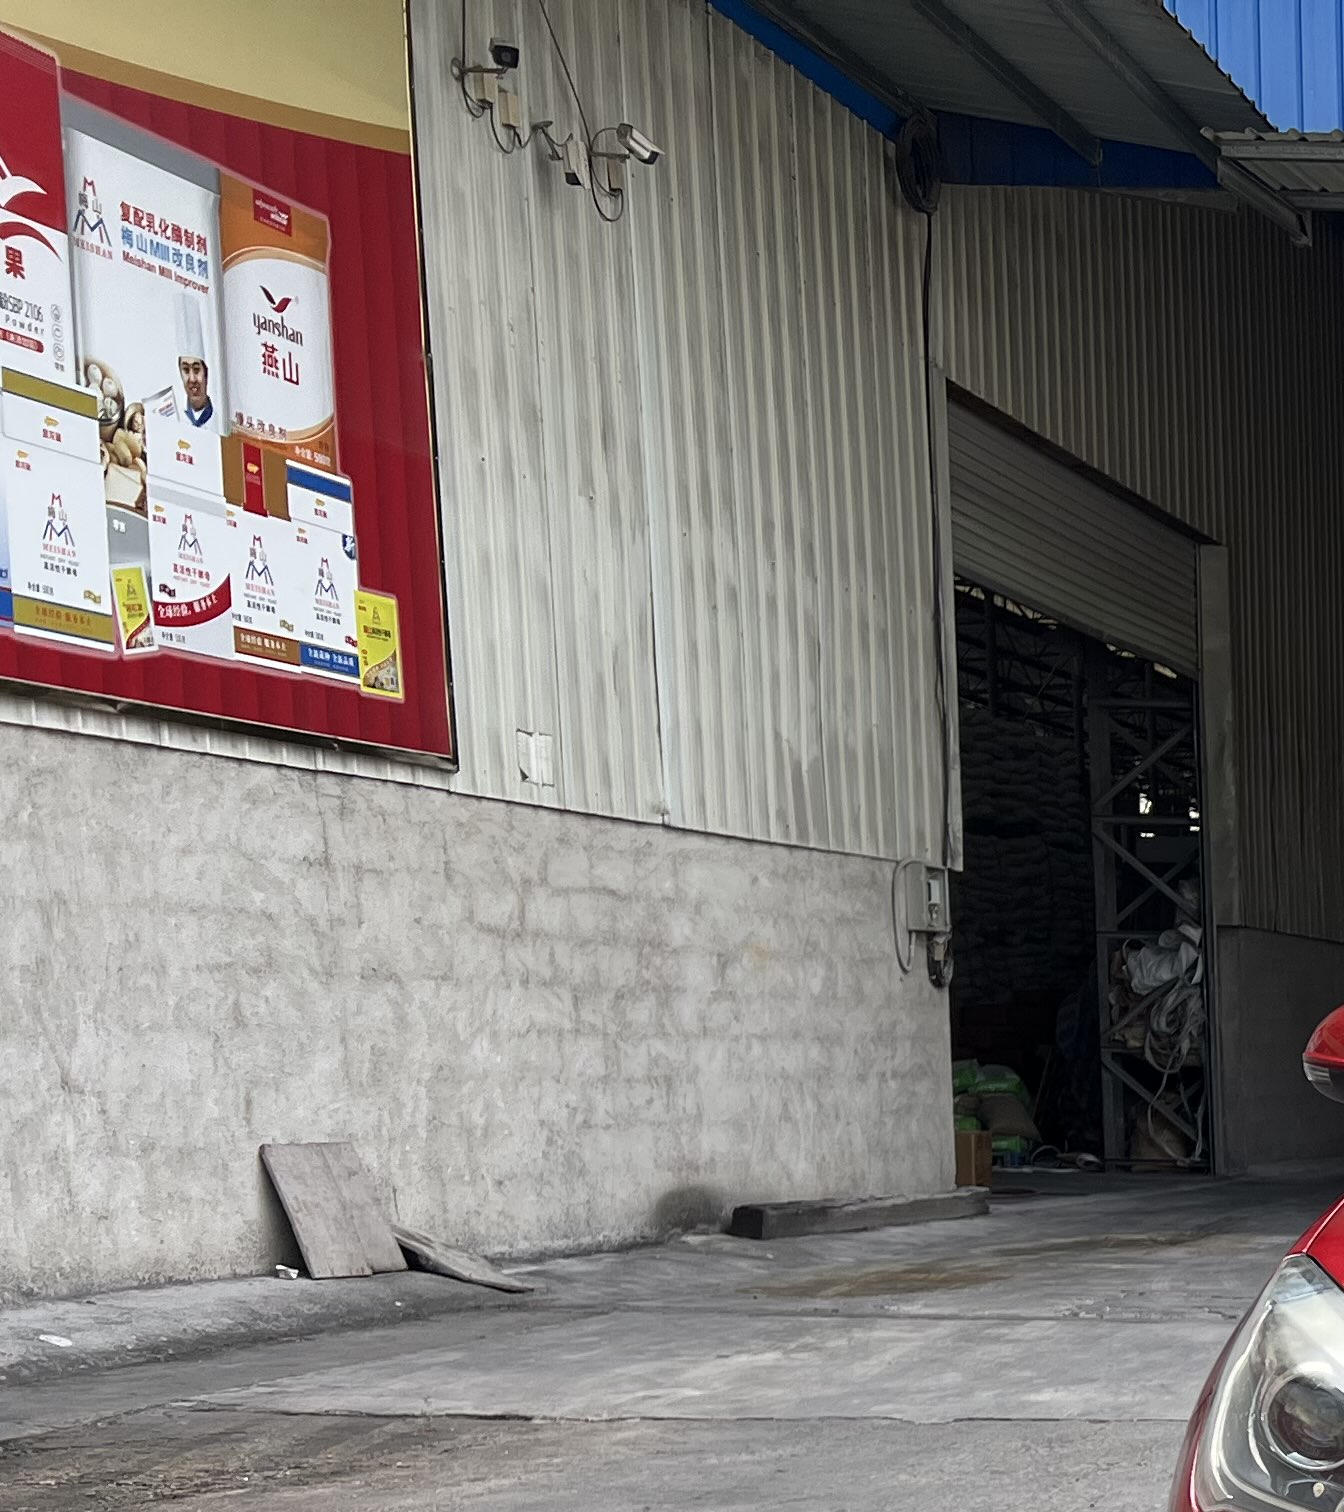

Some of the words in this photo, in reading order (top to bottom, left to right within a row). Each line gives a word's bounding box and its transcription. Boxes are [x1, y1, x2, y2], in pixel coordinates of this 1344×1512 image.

[72, 236, 113, 260] MEISHAN
[252, 312, 304, 347] yanshan
[261, 341, 300, 386] 燕山
